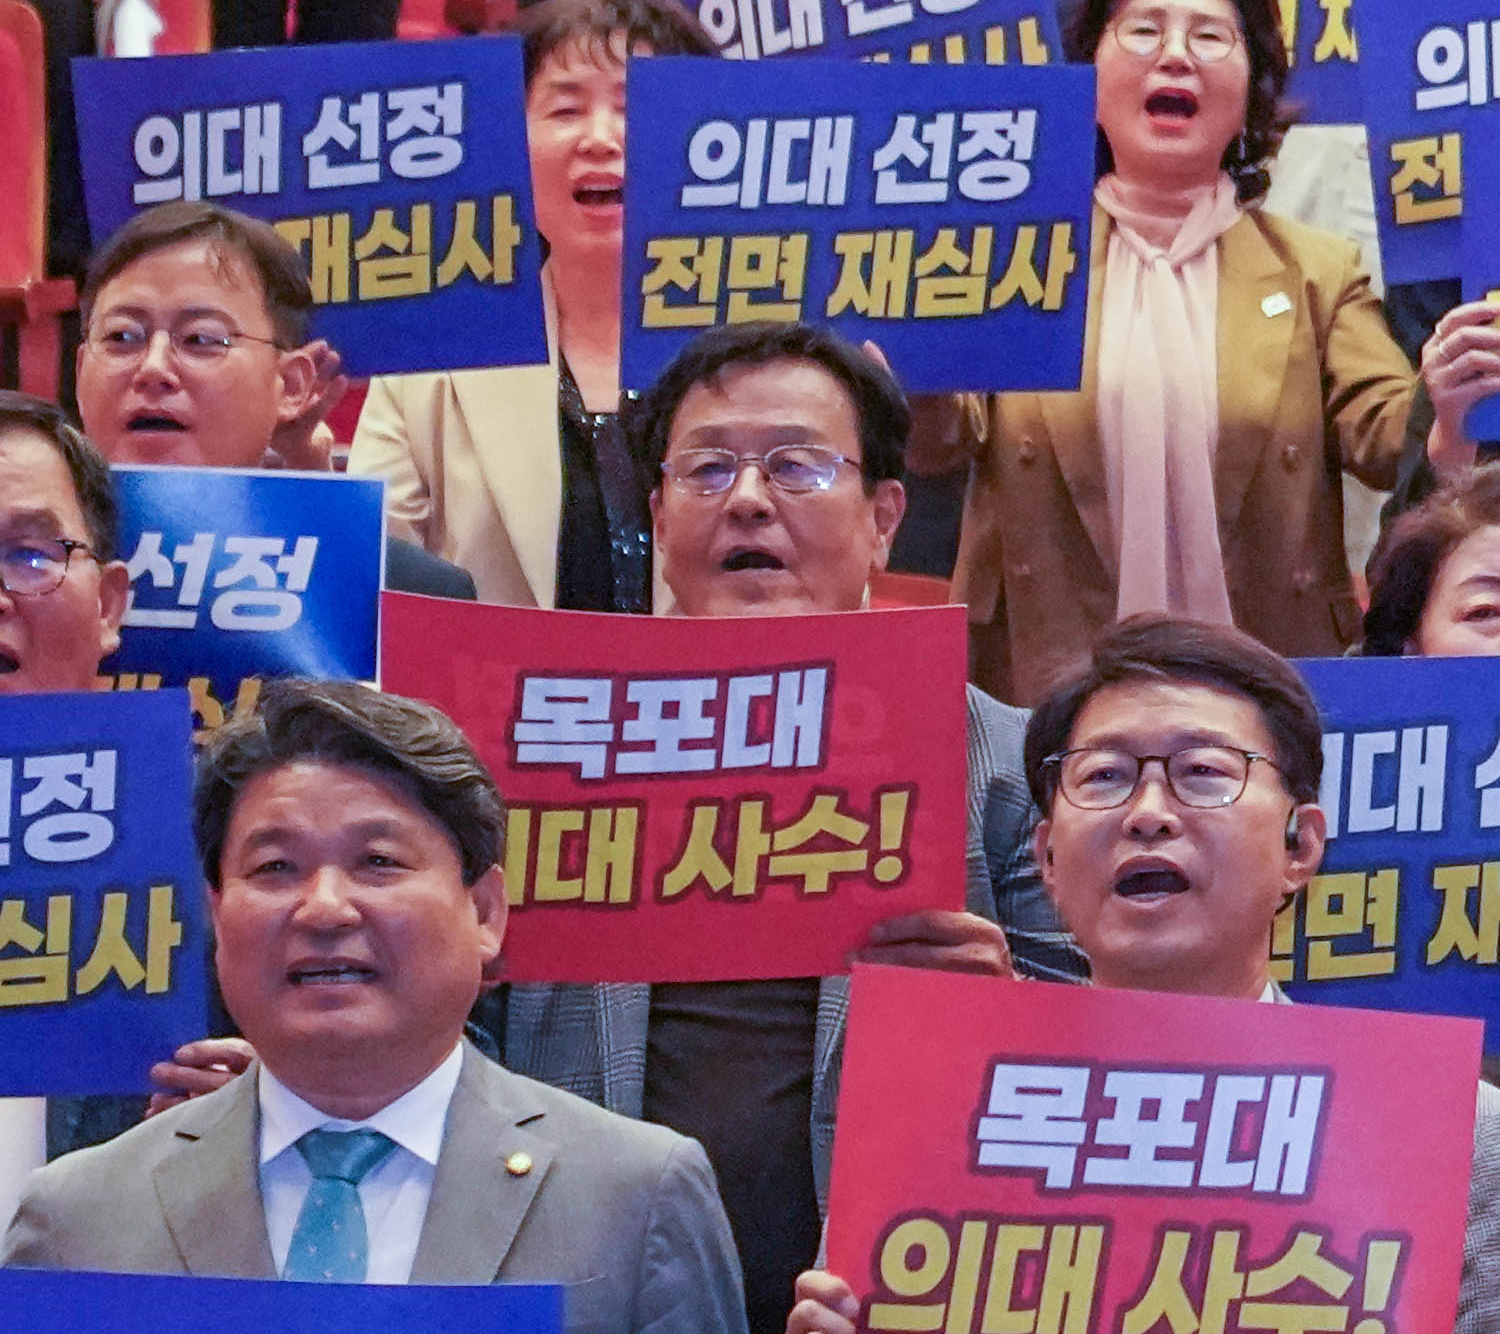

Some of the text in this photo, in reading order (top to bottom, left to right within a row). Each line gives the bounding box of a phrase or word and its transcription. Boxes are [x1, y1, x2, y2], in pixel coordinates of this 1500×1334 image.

[134, 83, 463, 205] 의대 선정
[682, 117, 853, 208] 의대
[873, 110, 1036, 203] 선정
[645, 234, 806, 326] 전면
[829, 224, 1075, 316] 재심사
[514, 669, 826, 778] 목포대
[663, 792, 908, 895] 사수!
[978, 1065, 1324, 1194] 목포대
